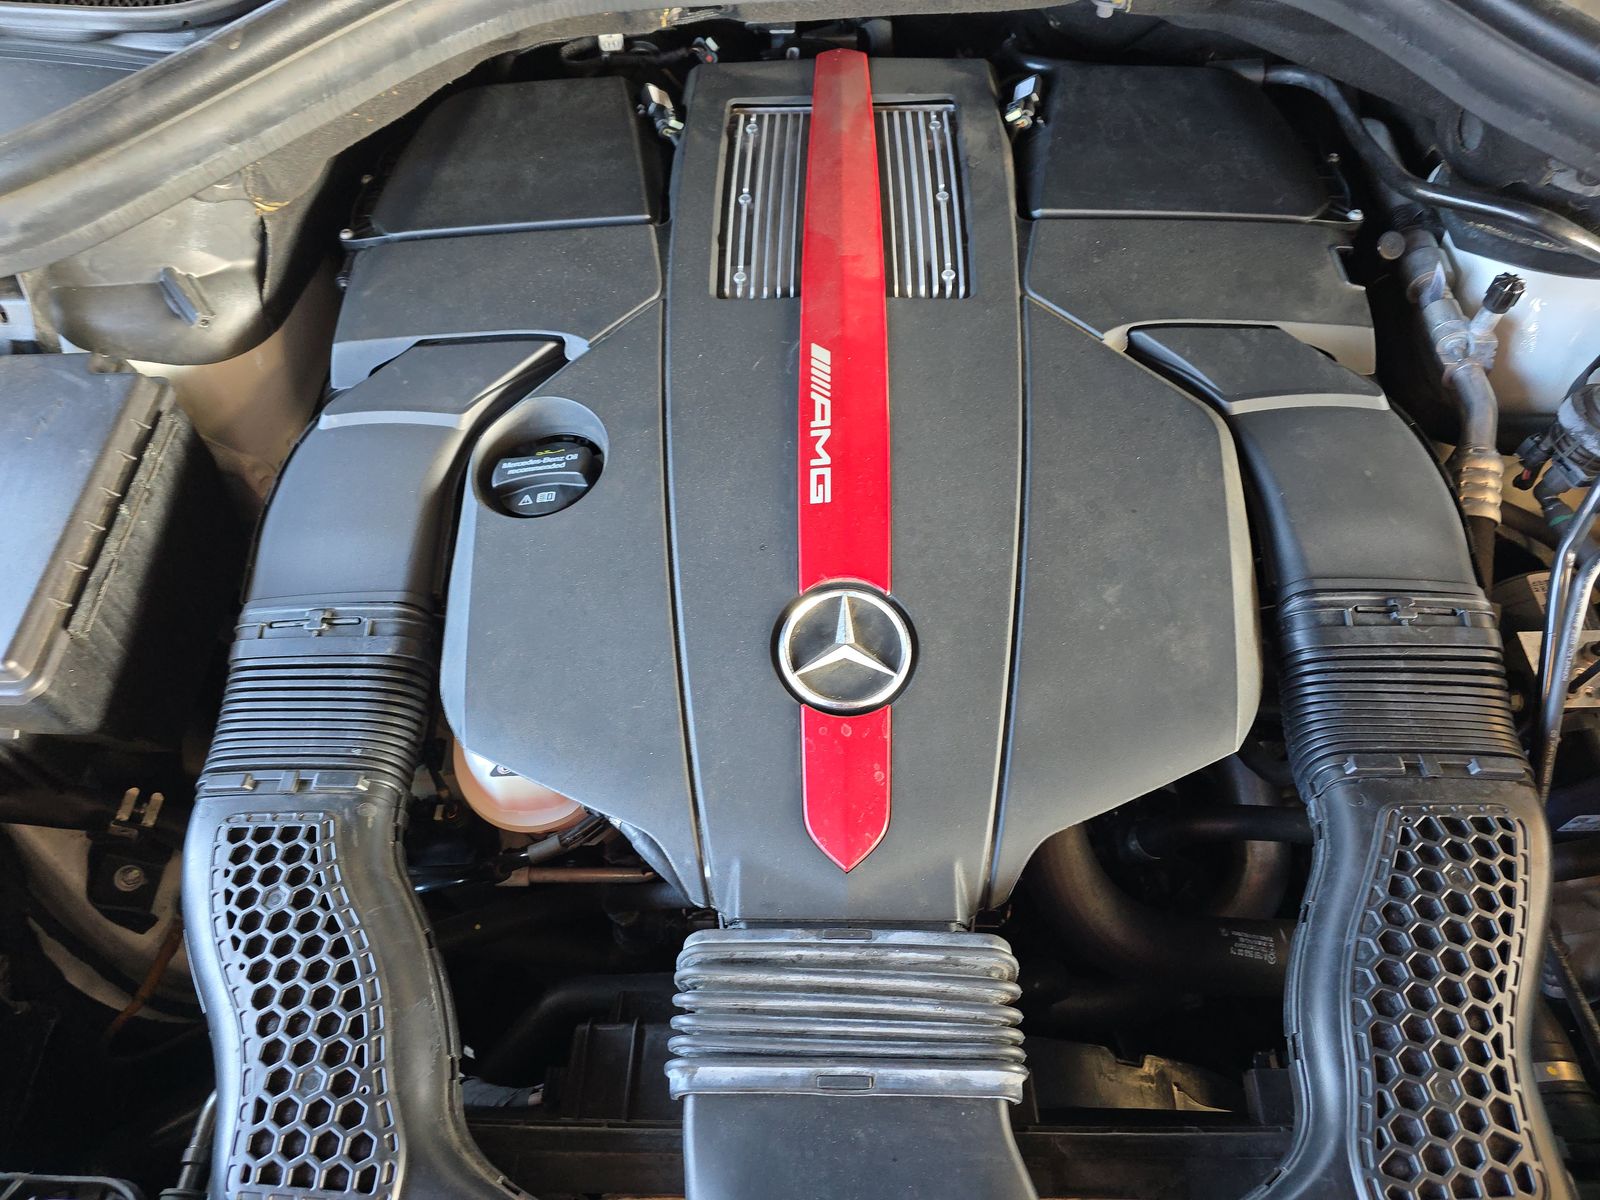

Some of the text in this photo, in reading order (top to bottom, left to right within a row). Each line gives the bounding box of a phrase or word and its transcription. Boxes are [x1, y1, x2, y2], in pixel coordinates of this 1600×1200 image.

[810, 391, 831, 504] AMG
[502, 456, 565, 469] Mercedes-Benz
[507, 462, 566, 474] recommended
